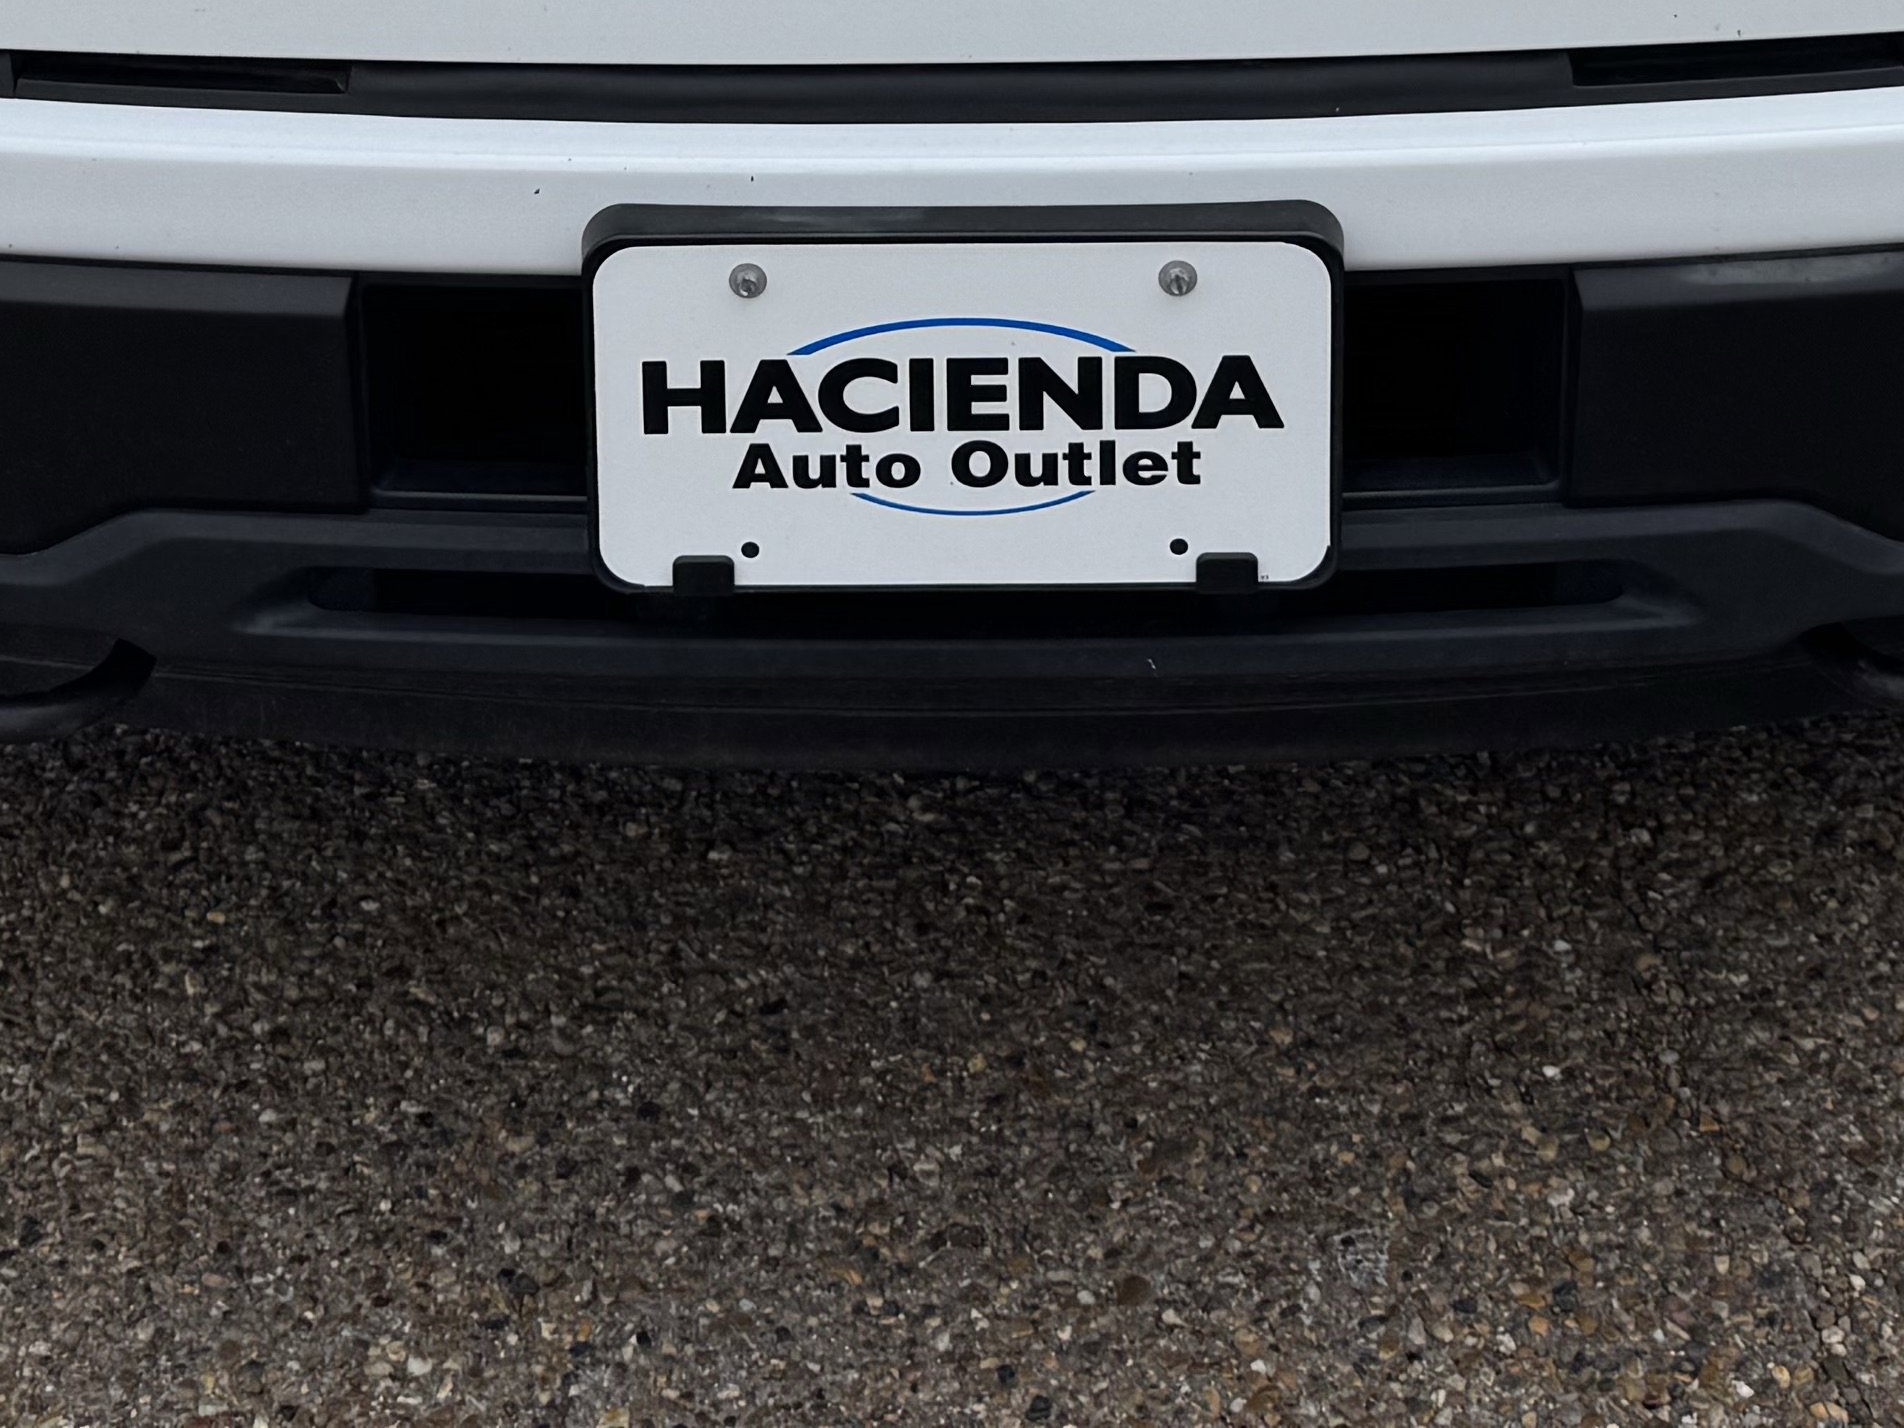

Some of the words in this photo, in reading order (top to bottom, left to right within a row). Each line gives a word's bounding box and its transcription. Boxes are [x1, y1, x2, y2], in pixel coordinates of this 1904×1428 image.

[641, 355, 1285, 435] HACIENDA
[732, 443, 921, 490] Auto
[950, 439, 1201, 488] Outlet
